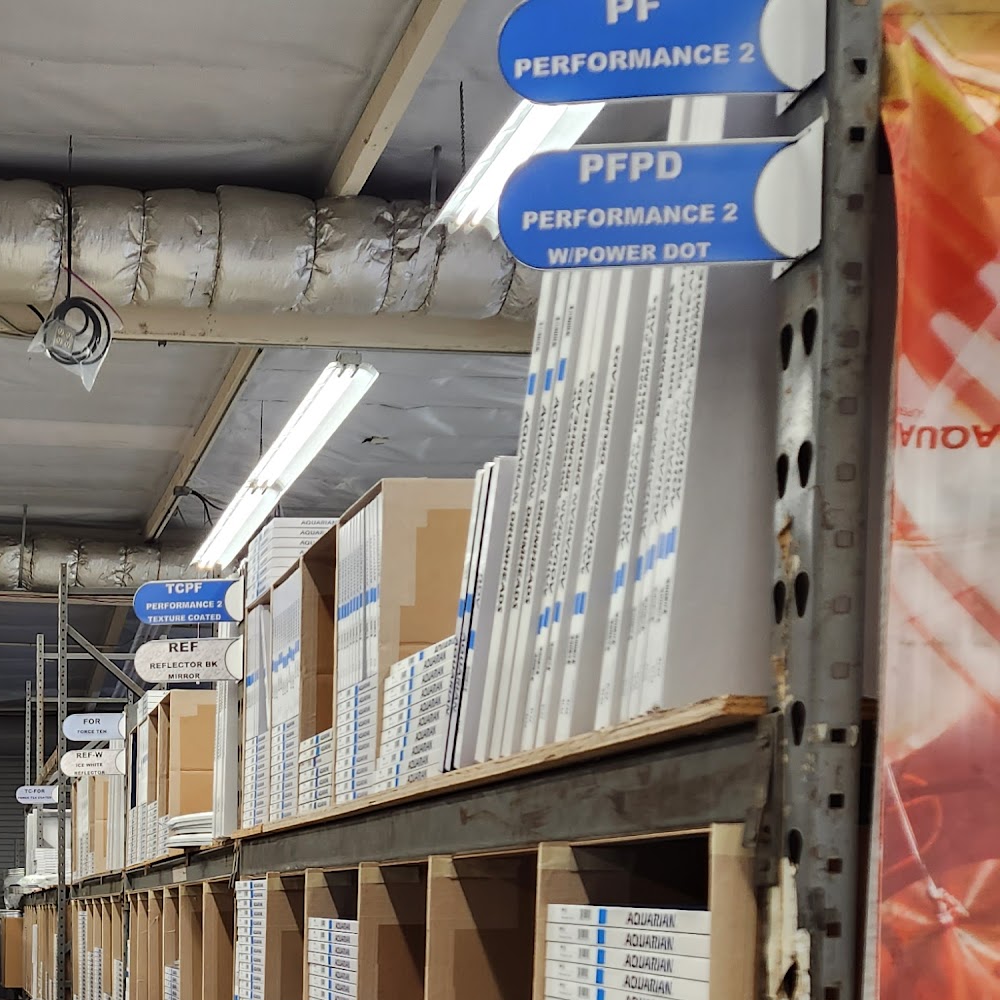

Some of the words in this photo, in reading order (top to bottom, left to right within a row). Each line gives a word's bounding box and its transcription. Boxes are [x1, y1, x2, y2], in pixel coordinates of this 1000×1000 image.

[606, 0, 660, 24] PF
[514, 44, 730, 79] PERFORMANCE
[739, 43, 755, 63] 2
[579, 151, 683, 183] PFPD
[522, 204, 716, 231] PERFORMANCE
[722, 203, 738, 223] 2
[548, 244, 657, 265] W/POWER
[664, 242, 711, 261] DOT
[166, 582, 202, 594] TCPF
[146, 601, 214, 610] PERFORMANCE
[148, 614, 186, 623] TEXTURE
[168, 642, 198, 652] REF
[150, 661, 202, 669] REFLECTOR
